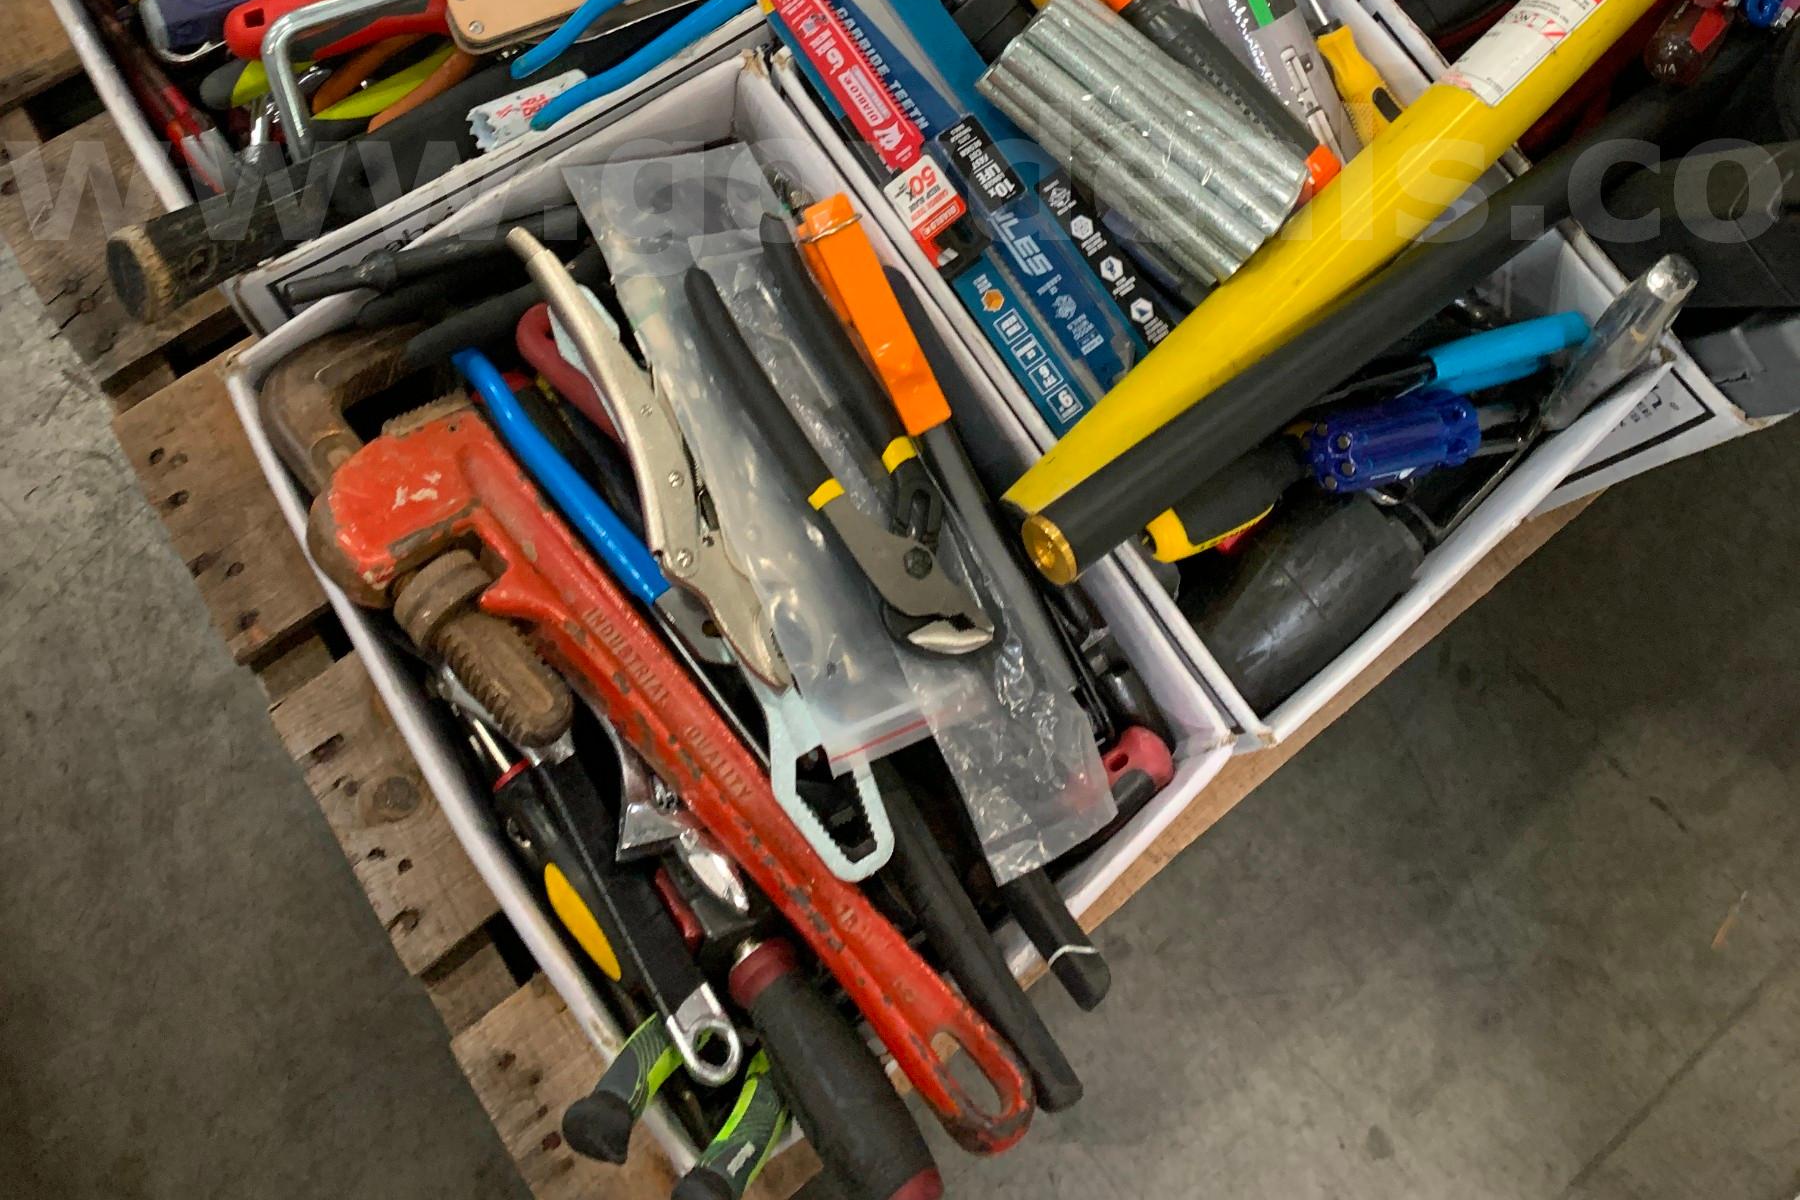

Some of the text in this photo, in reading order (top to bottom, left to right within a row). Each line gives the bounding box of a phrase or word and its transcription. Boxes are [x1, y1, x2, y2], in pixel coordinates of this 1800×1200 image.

[890, 75, 929, 132] TEETH
[973, 161, 1002, 184] LIFE
[684, 724, 754, 803] QUALITY
